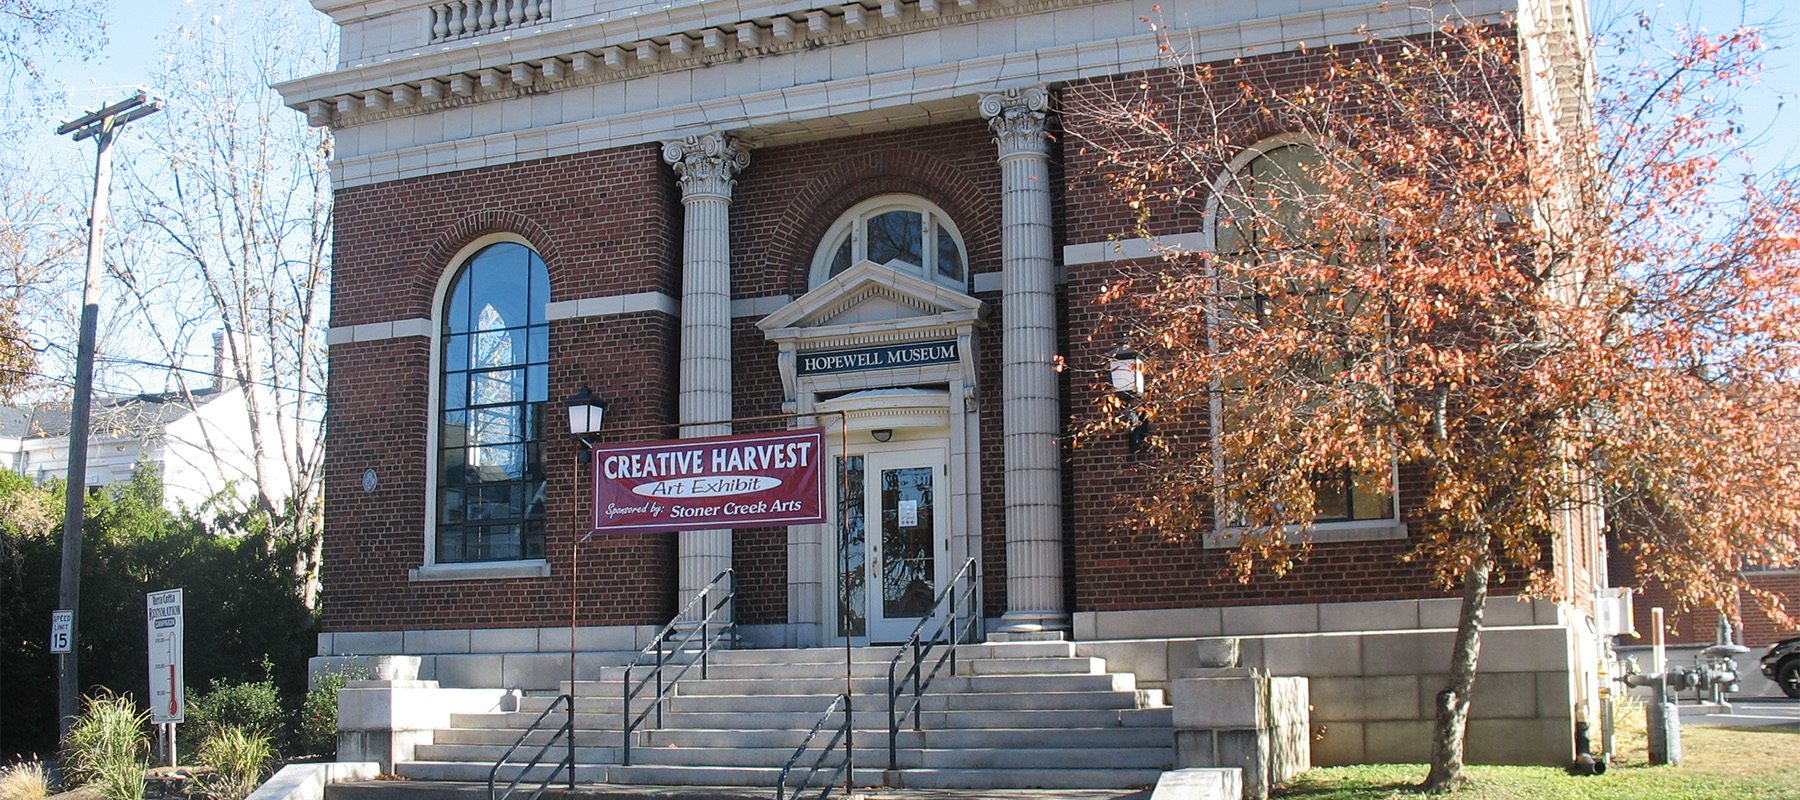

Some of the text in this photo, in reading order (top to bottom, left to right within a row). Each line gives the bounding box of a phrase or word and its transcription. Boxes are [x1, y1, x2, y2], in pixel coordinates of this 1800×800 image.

[804, 345, 955, 371] HOPEWELL MUSEUM
[604, 442, 811, 480] CREATIVE HARVEST
[651, 477, 762, 496] Art Exhibit
[605, 499, 802, 519] Sponsored by: Stoner Creek Arts
[53, 614, 71, 622] SPEED
[54, 623, 69, 631] LIMIT
[54, 633, 68, 649] 15
